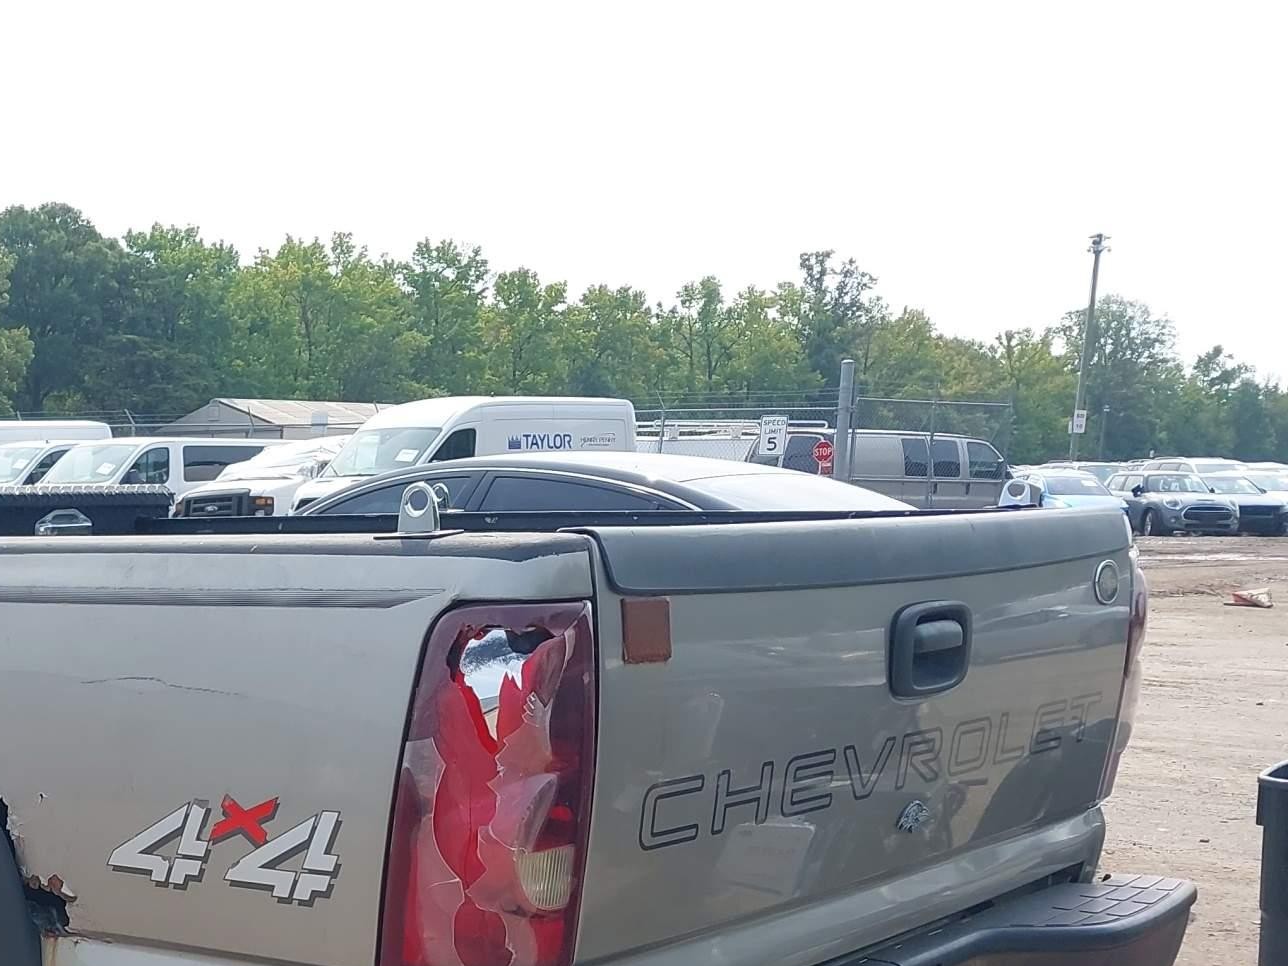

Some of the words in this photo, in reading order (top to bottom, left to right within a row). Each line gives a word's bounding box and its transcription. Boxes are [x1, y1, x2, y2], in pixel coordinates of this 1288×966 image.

[522, 433, 572, 449] TAYLOR
[766, 436, 778, 451] 5
[814, 447, 833, 457] STOP
[638, 692, 1104, 851] CHEVROLET
